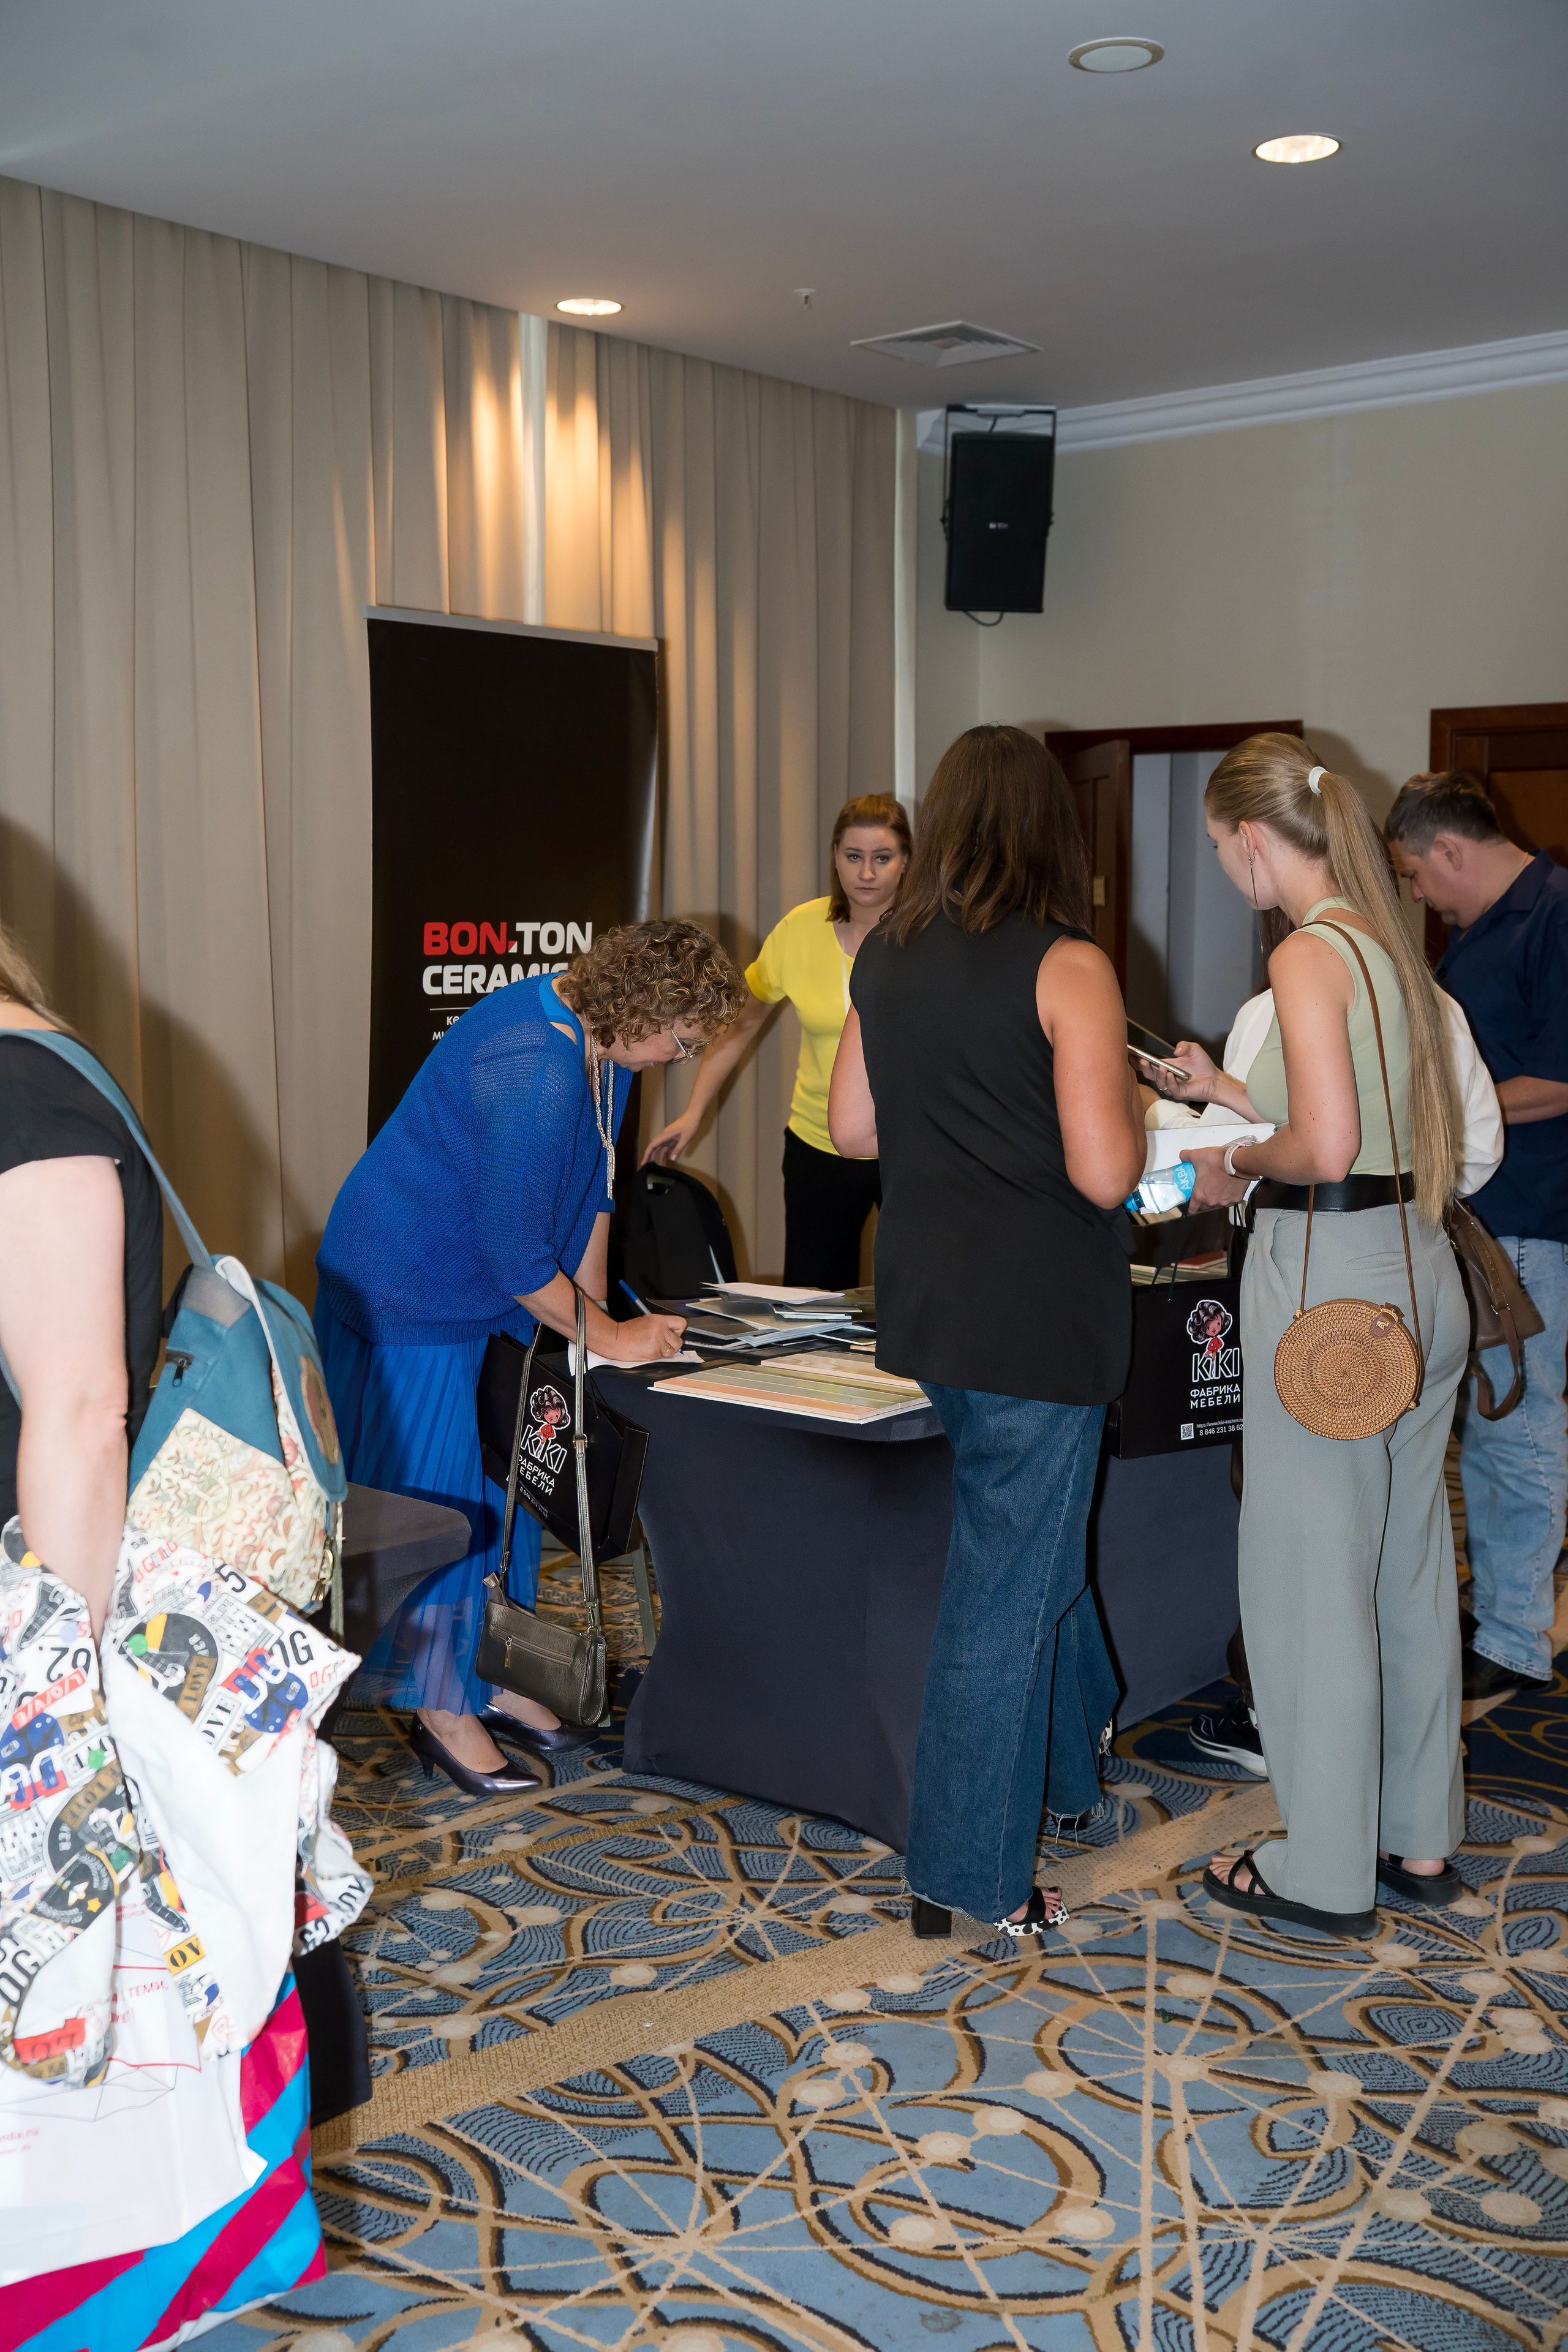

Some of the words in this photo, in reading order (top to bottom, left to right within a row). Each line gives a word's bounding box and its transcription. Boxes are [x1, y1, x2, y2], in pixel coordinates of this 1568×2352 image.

[1190, 1383, 1241, 1398] ФАБРИКА
[1190, 1393, 1240, 1409] МЕБЕЛИ
[518, 1464, 553, 1496] ЕБЕЛИ
